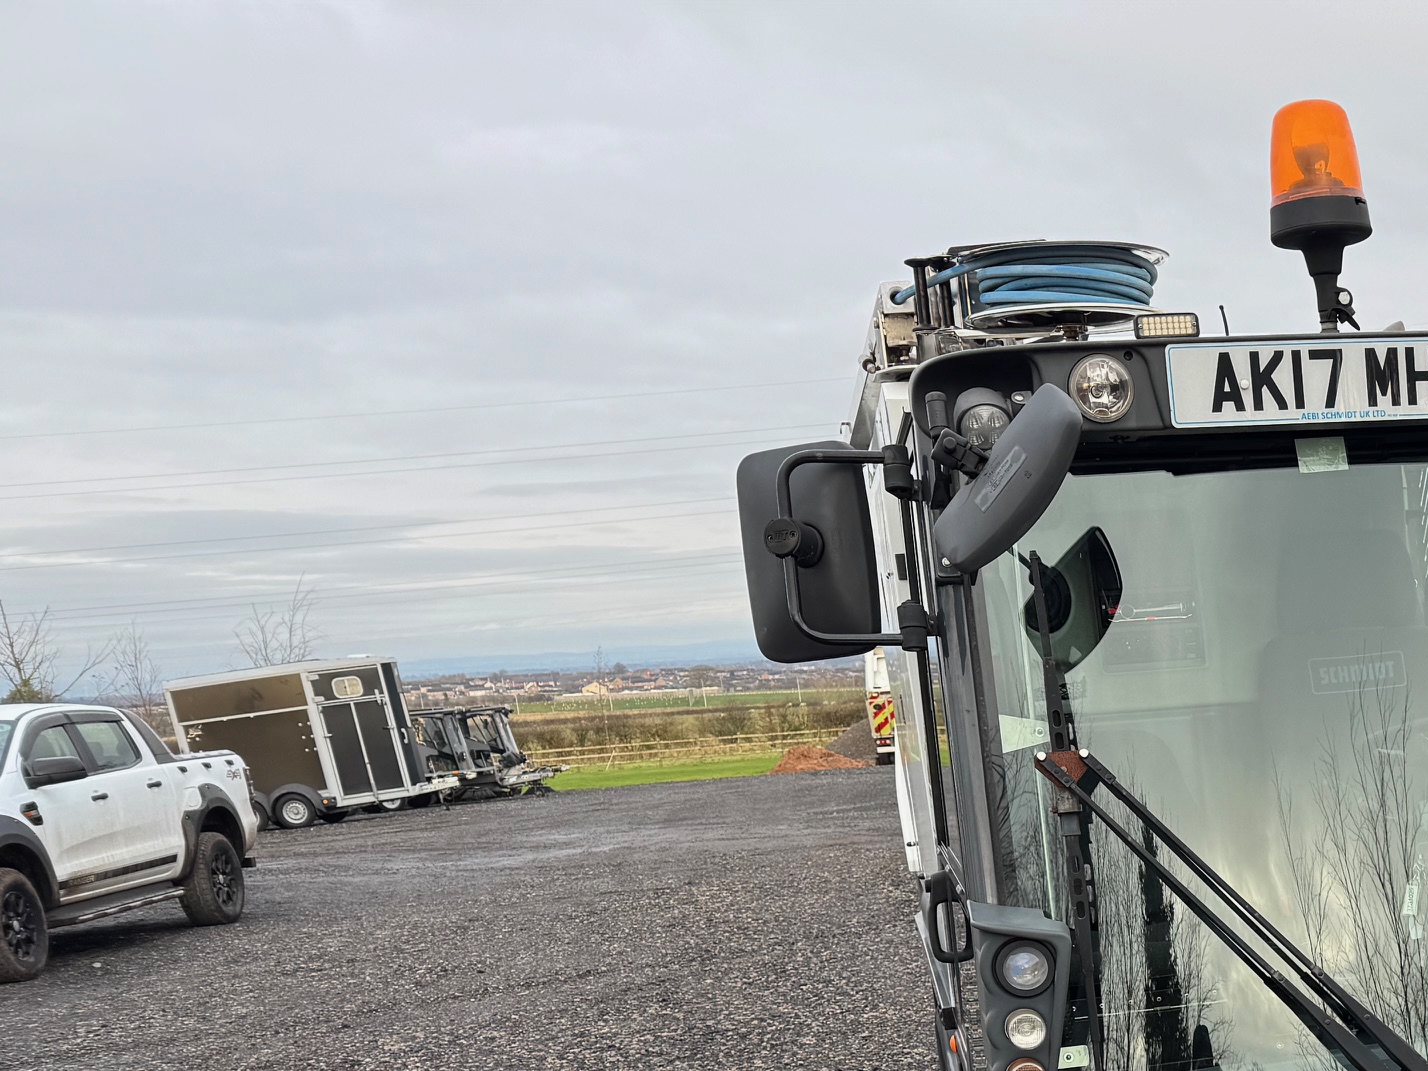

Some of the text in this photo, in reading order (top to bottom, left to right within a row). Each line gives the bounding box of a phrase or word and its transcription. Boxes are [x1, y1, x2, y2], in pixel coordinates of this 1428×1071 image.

[1212, 349, 1343, 413] AK17
[1301, 412, 1319, 420] AEBI
[1321, 411, 1357, 420] SCHMIDT
[1359, 410, 1370, 418] UK
[1372, 410, 1386, 418] LTD
[1319, 661, 1394, 685] SCHMIDT
